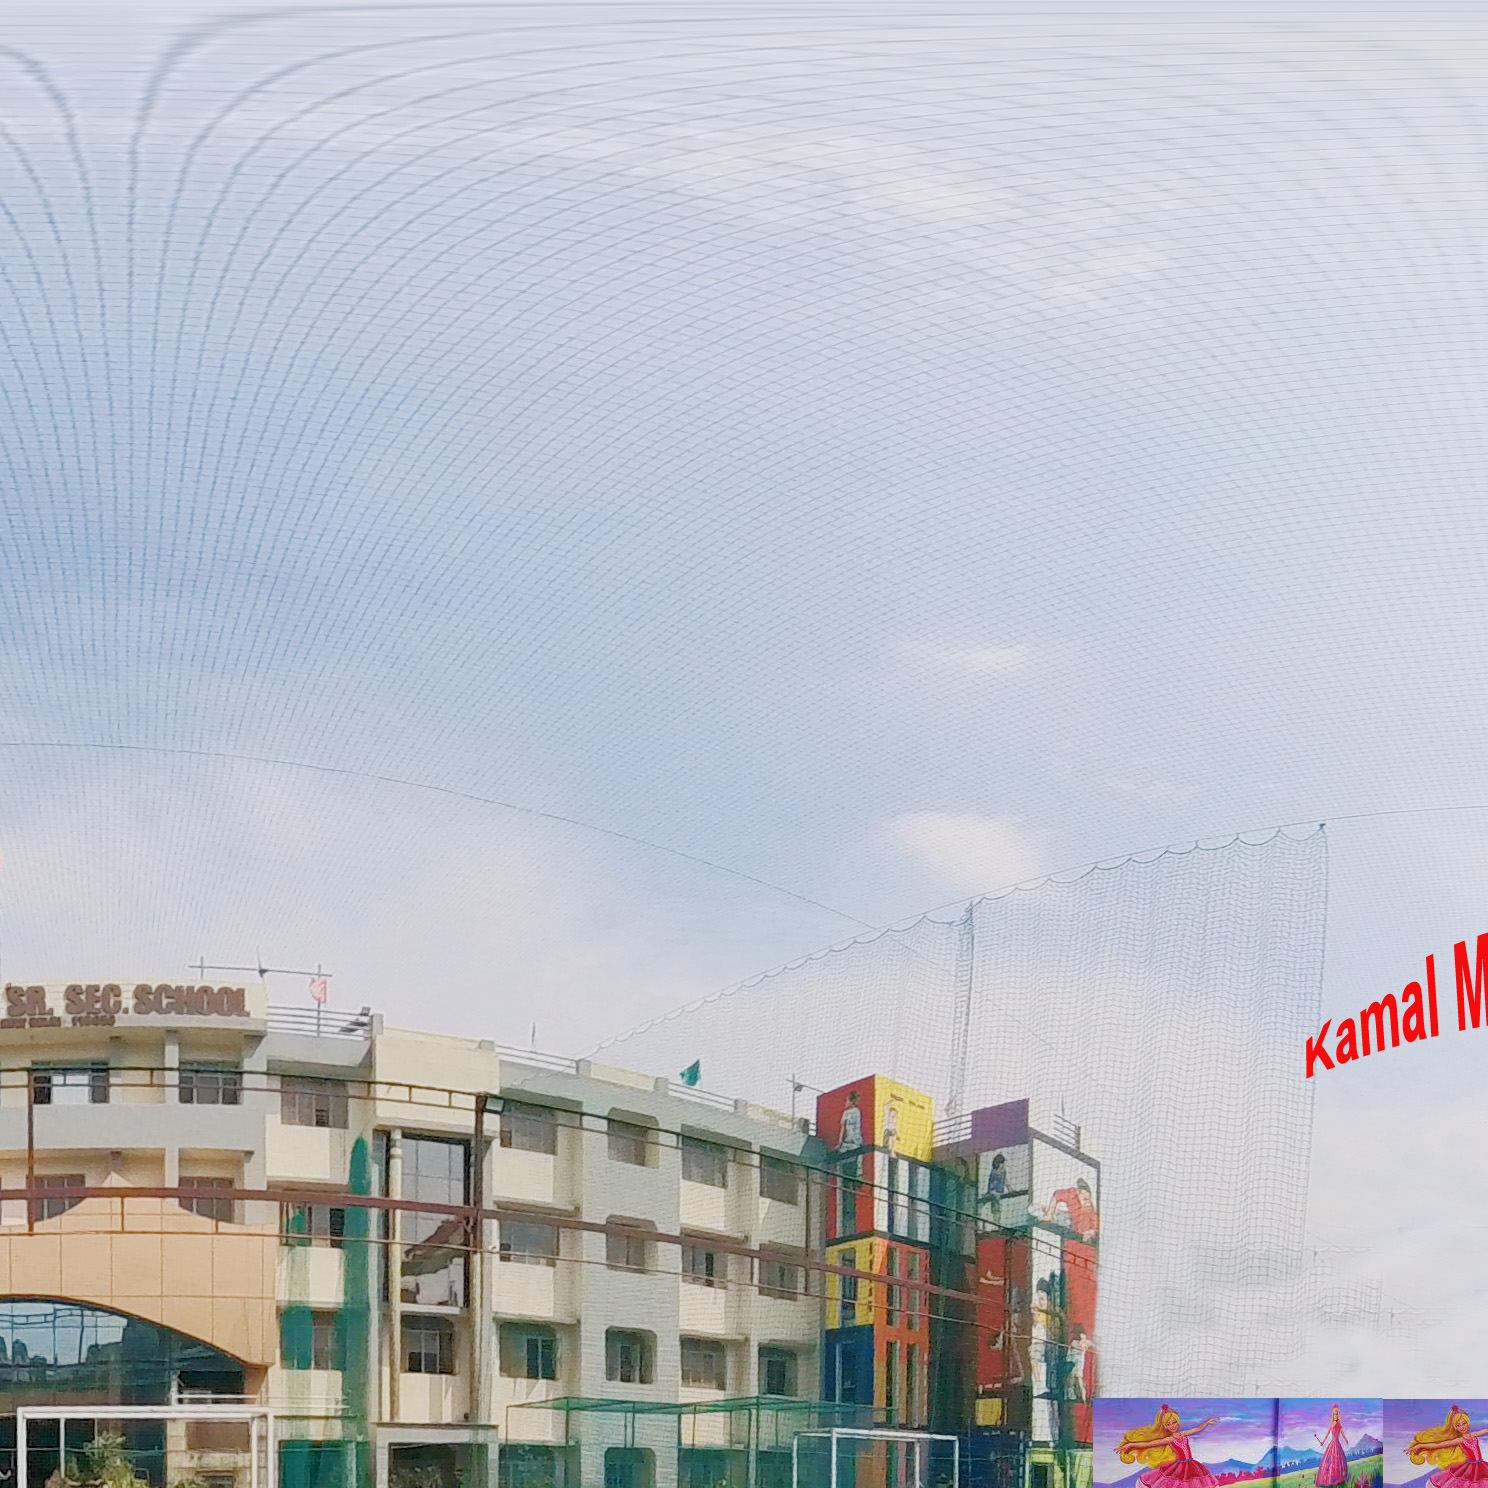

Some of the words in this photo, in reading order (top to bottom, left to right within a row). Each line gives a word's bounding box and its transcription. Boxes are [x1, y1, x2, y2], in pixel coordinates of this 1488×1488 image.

[5, 985, 54, 1017] SR.
[64, 983, 129, 1015] SEC.
[133, 983, 250, 1018] SCHOOL
